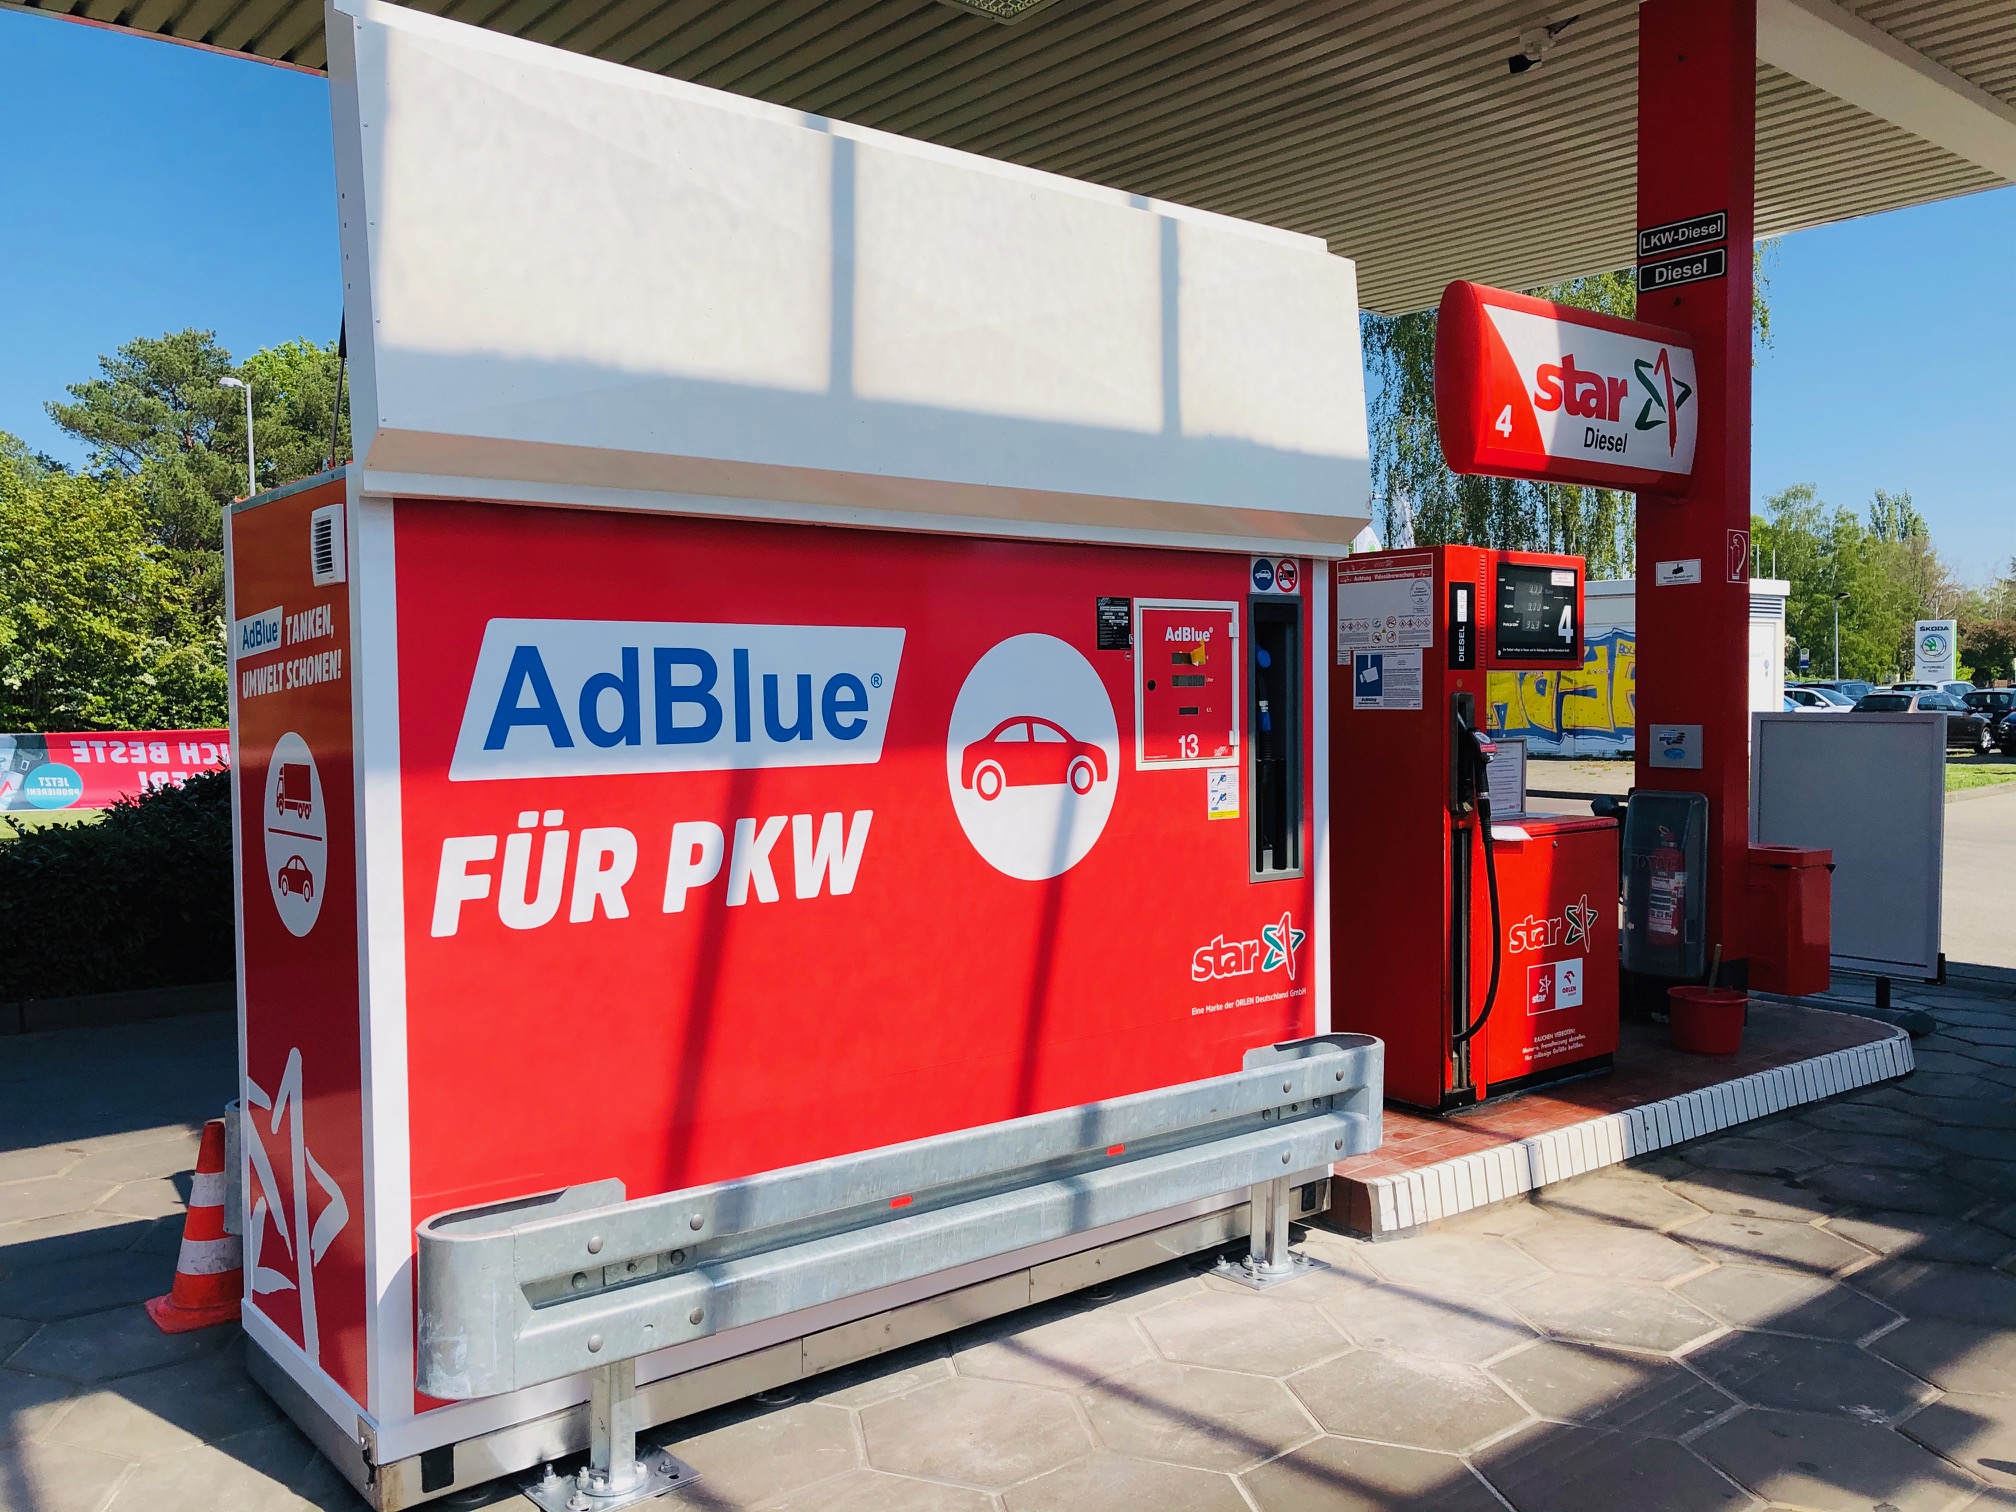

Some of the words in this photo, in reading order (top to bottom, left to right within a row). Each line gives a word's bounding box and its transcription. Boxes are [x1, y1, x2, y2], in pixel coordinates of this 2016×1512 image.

[1642, 219, 1721, 250] LKW-Diesel
[1655, 258, 1707, 283] Diesel
[1534, 353, 1628, 422] star
[1495, 404, 1513, 438] 4
[1584, 426, 1628, 453] Diesel
[285, 603, 335, 646] TANKEN,
[1557, 604, 1574, 644] 4
[1458, 625, 1466, 662] DIESEL
[242, 662, 284, 699] UMWELT
[286, 649, 342, 690] SCHONEN!
[1178, 733, 1199, 759] 13
[430, 809, 638, 938] FÜR
[662, 809, 874, 914] PKW
[1509, 914, 1562, 953] star
[1191, 934, 1259, 982] star
[1191, 1006, 1204, 1016] Eine
[1205, 1003, 1223, 1014] Marke
[1224, 1001, 1234, 1010] der
[1235, 996, 1255, 1007] ORLEN
[1255, 990, 1289, 1004] Deutschland
[1289, 987, 1307, 997] GmbH
[1531, 993, 1547, 1004] star
[1561, 986, 1577, 994] ORLEN
[1534, 1033, 1553, 1044] RAUCHEN
